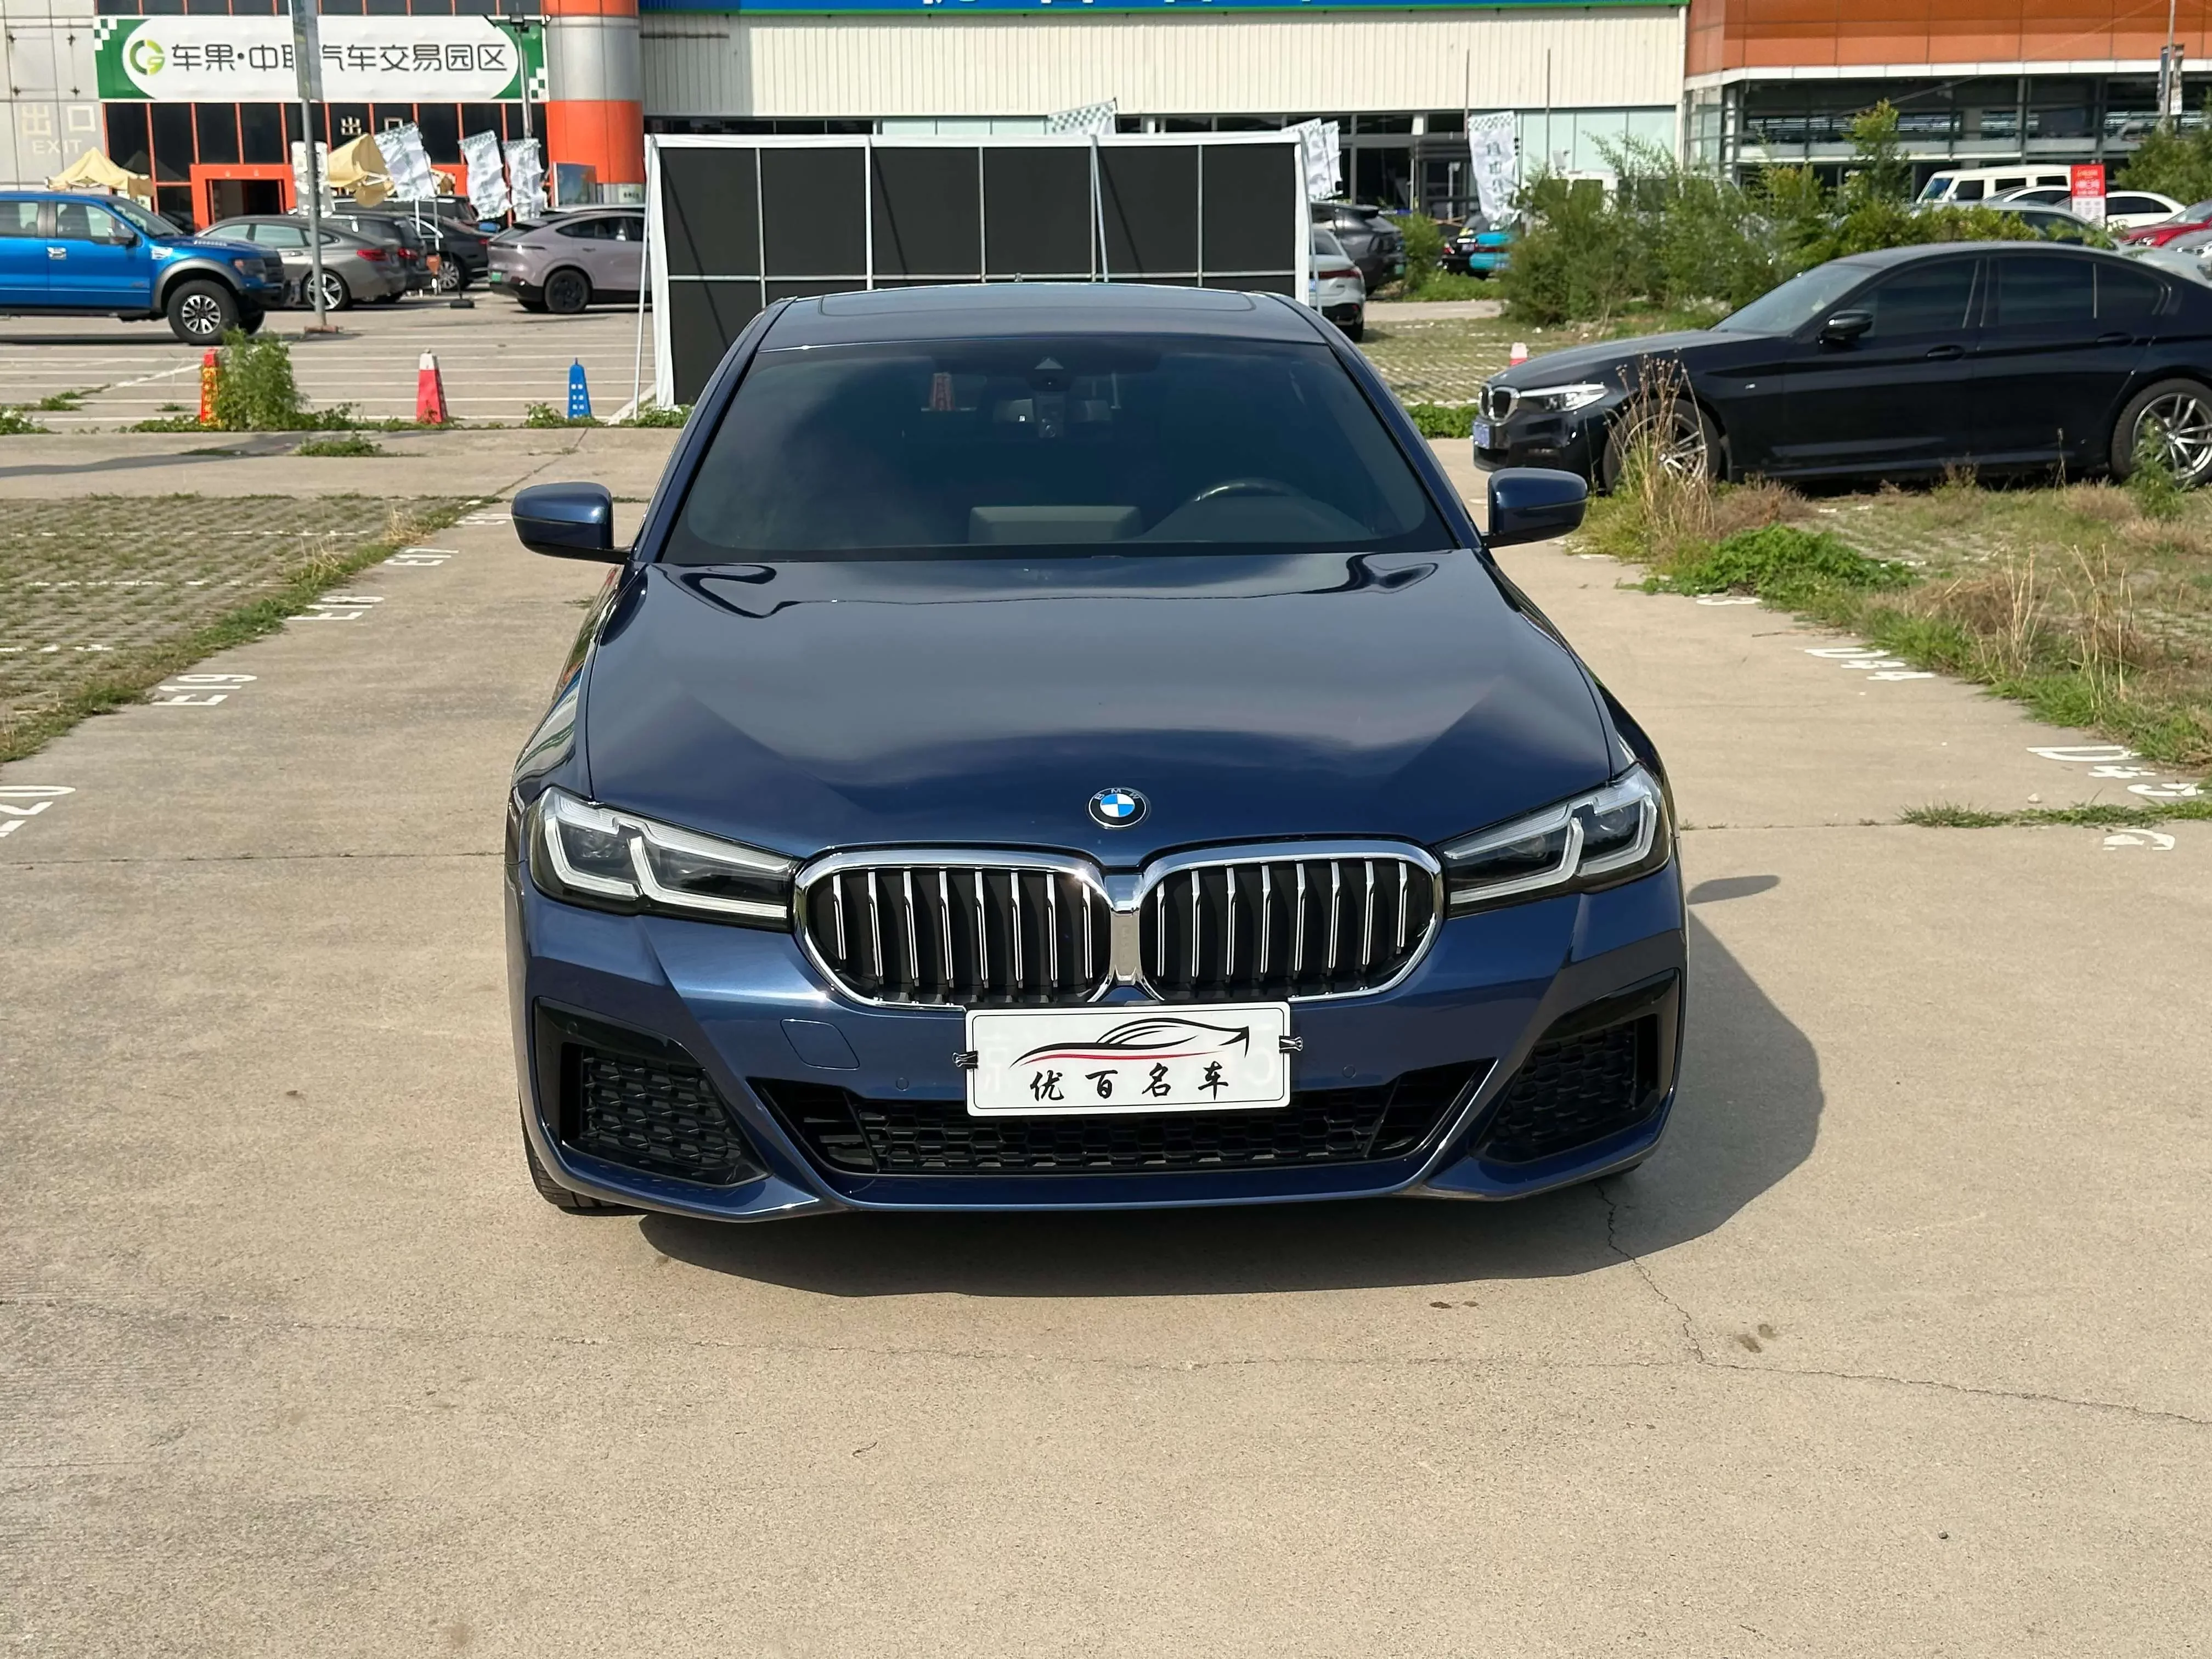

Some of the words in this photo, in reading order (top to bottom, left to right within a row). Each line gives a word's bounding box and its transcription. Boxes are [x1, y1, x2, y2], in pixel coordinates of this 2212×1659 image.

[22, 103, 96, 136] 出口
[32, 139, 82, 154] EXIT
[287, 596, 385, 620] E18
[151, 674, 258, 706] E19
[1094, 788, 1141, 800] BMW
[1030, 1060, 1229, 1102] 优百名车
